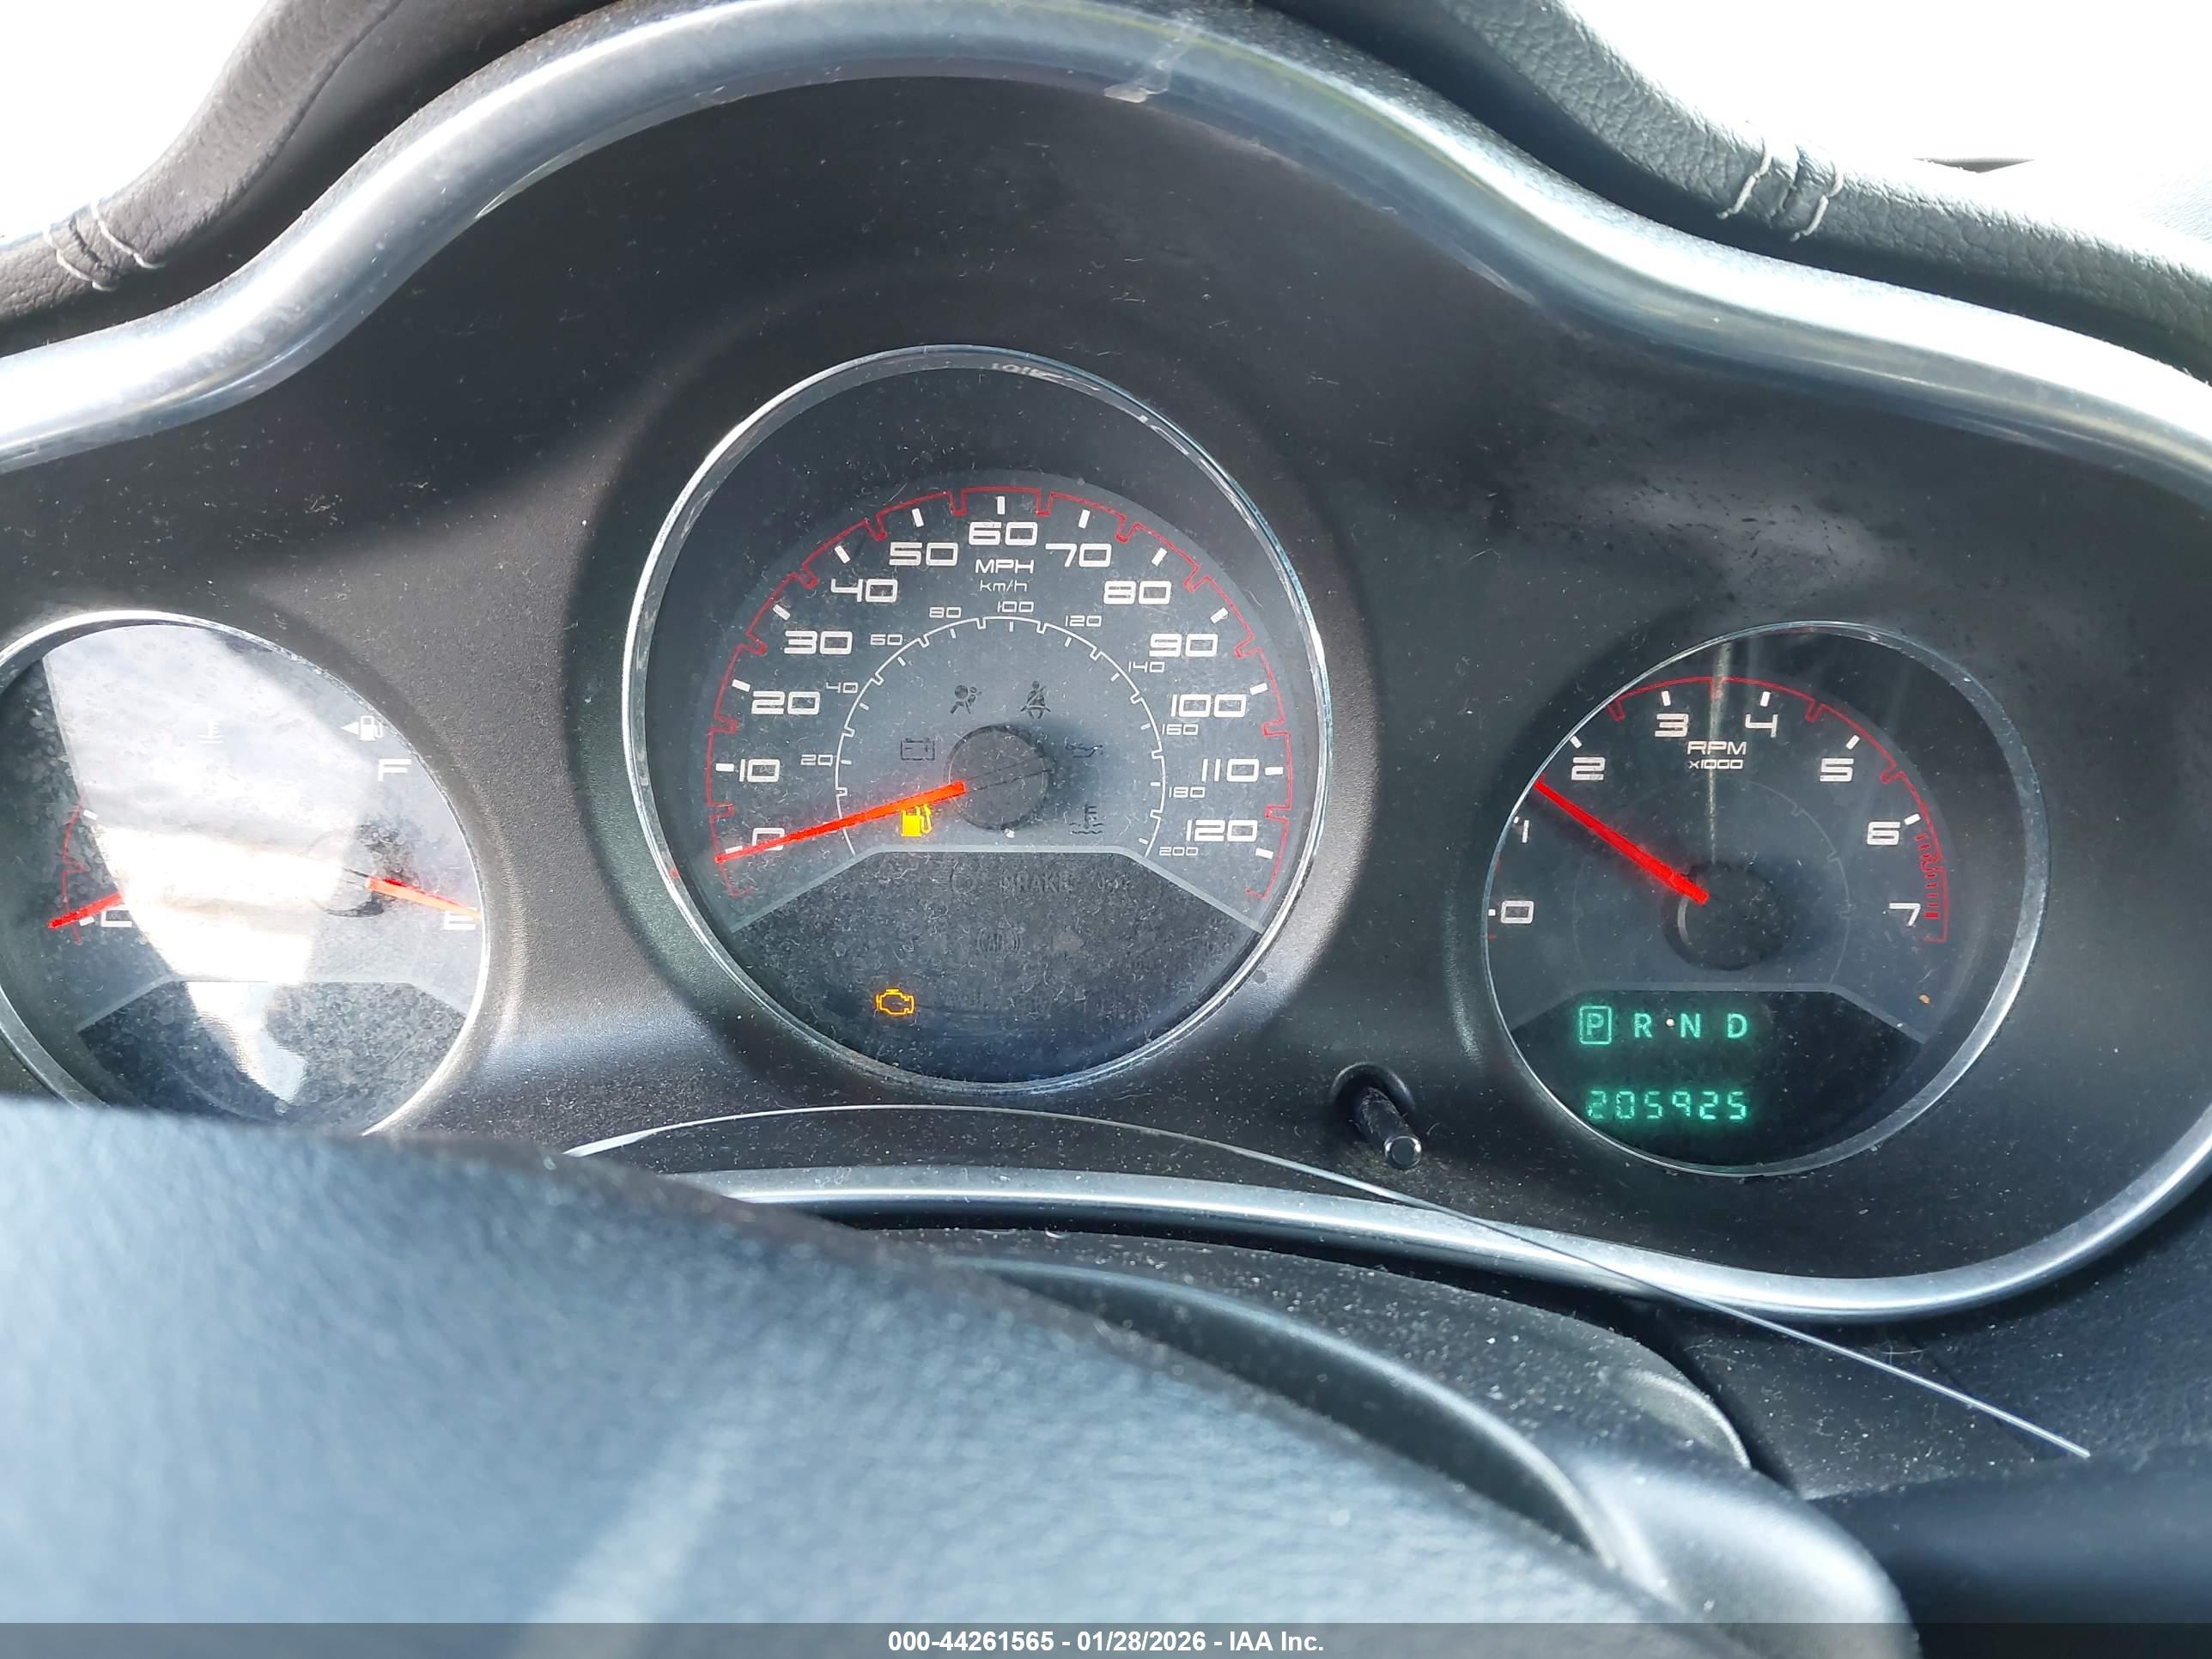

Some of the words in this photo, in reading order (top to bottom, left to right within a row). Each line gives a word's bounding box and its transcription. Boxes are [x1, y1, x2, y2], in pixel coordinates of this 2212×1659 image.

[968, 520, 1038, 546] 60
[888, 542, 959, 567] 50
[975, 558, 1035, 574] MPH
[1044, 543, 1112, 568] 70
[830, 578, 898, 603] 40
[980, 579, 1028, 592] km/h
[1103, 580, 1172, 605] 80
[928, 606, 963, 619] 80
[996, 601, 1035, 613] 100
[1064, 615, 1103, 628] 120
[783, 629, 854, 655] 30
[869, 634, 903, 646] 60
[1148, 632, 1219, 658] 90
[1127, 661, 1166, 673] 140
[824, 681, 859, 694] 40
[750, 690, 821, 715] 20
[1170, 693, 1247, 718] 100
[1161, 723, 1199, 736] 160
[1654, 713, 1689, 738] 3
[1744, 714, 1779, 738] 4
[799, 753, 834, 767] 20
[1686, 740, 1747, 756] RPM
[377, 758, 413, 782] F
[738, 758, 781, 783] 10
[1200, 757, 1260, 783] 110
[1571, 757, 1605, 781] 2
[1819, 757, 1855, 782] 5
[1168, 786, 1206, 799] 180
[751, 827, 786, 851] 0
[1185, 818, 1259, 843] 120
[1522, 819, 1530, 843] 1
[1866, 821, 1901, 846] 6
[1159, 846, 1199, 857] 200
[1500, 900, 1534, 925] 0
[1887, 902, 1922, 927] 7
[1586, 1012, 1605, 1036] P
[1633, 1012, 1653, 1038] R
[1680, 1012, 1701, 1038] N
[1727, 1012, 1748, 1038] D
[1588, 1090, 1747, 1120] 205925
